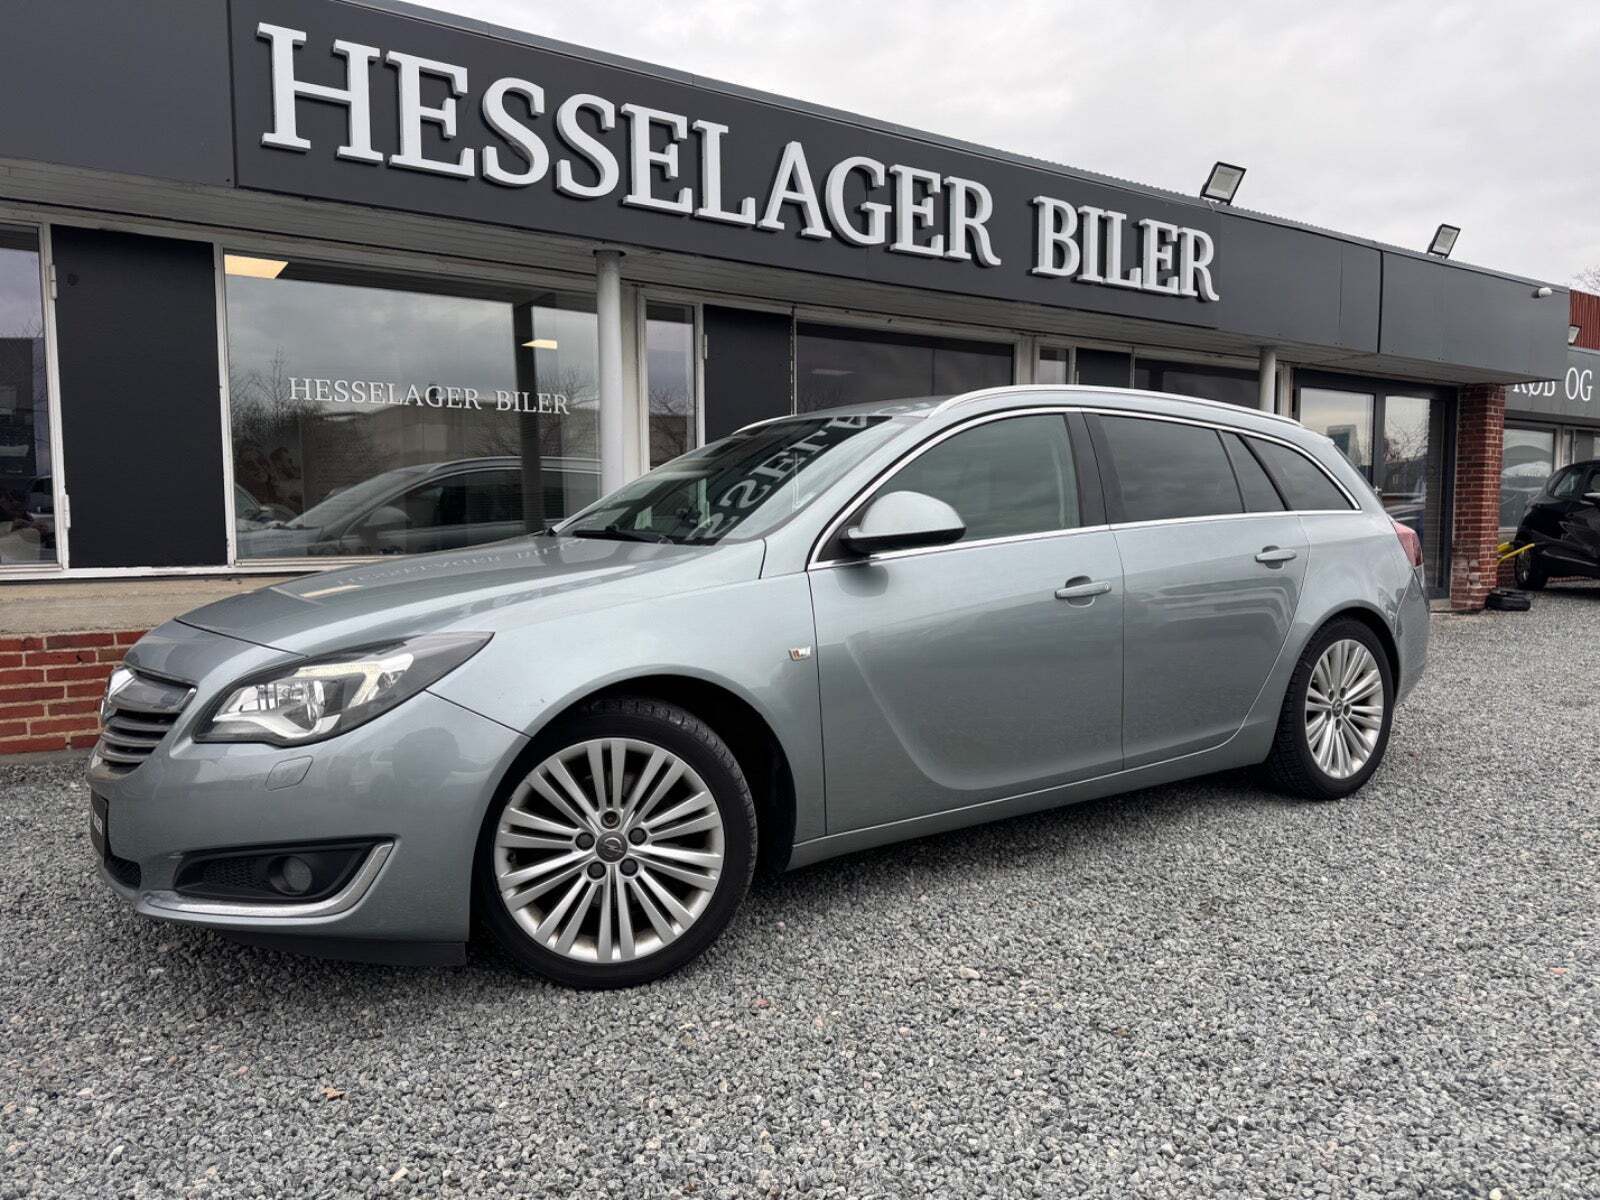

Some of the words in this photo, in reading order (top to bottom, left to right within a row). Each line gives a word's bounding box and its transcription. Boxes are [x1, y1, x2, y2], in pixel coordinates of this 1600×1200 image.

[256, 22, 1002, 267] HESSELAGER
[1032, 195, 1220, 302] BILER
[288, 377, 482, 410] HESSELAGER
[495, 389, 570, 415] BILER
[1565, 367, 1593, 402] OG
